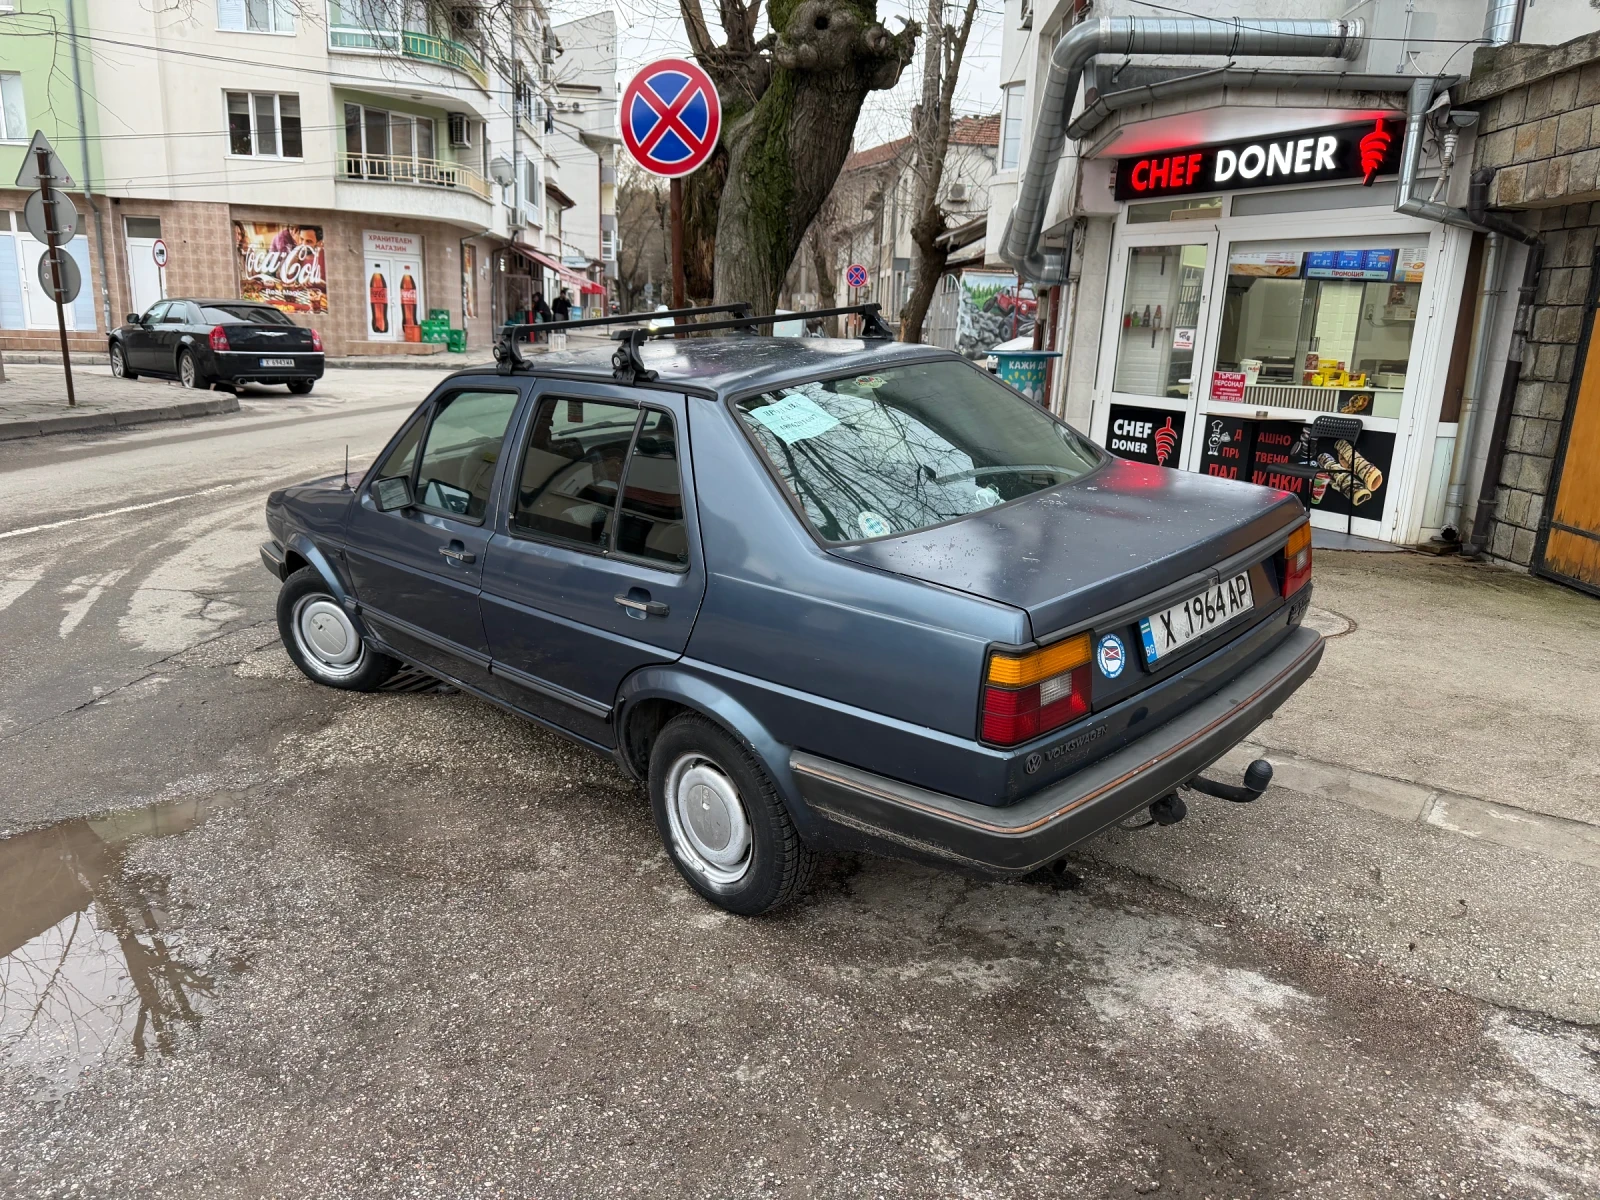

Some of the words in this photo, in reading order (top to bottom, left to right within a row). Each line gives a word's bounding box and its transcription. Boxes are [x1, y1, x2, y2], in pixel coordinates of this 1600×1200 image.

[1132, 154, 1202, 191] CHEF
[1214, 136, 1337, 182] DONER
[368, 234, 412, 244] ХРАНИТЕЛЕН
[375, 243, 407, 252] МАГАЗИН
[1331, 270, 1365, 278] ПРОМОЦИЯ
[1008, 360, 1036, 370] КАЖИ
[1218, 372, 1241, 380] ТЪРСИМ
[1214, 380, 1244, 388] ПЕРСОНАЛ
[1113, 419, 1153, 439] CHEF
[1111, 438, 1148, 454] DONER
[1160, 610, 1177, 648] X
[1146, 644, 1155, 657] BG
[1045, 726, 1108, 761] VOLKSWAGEN
